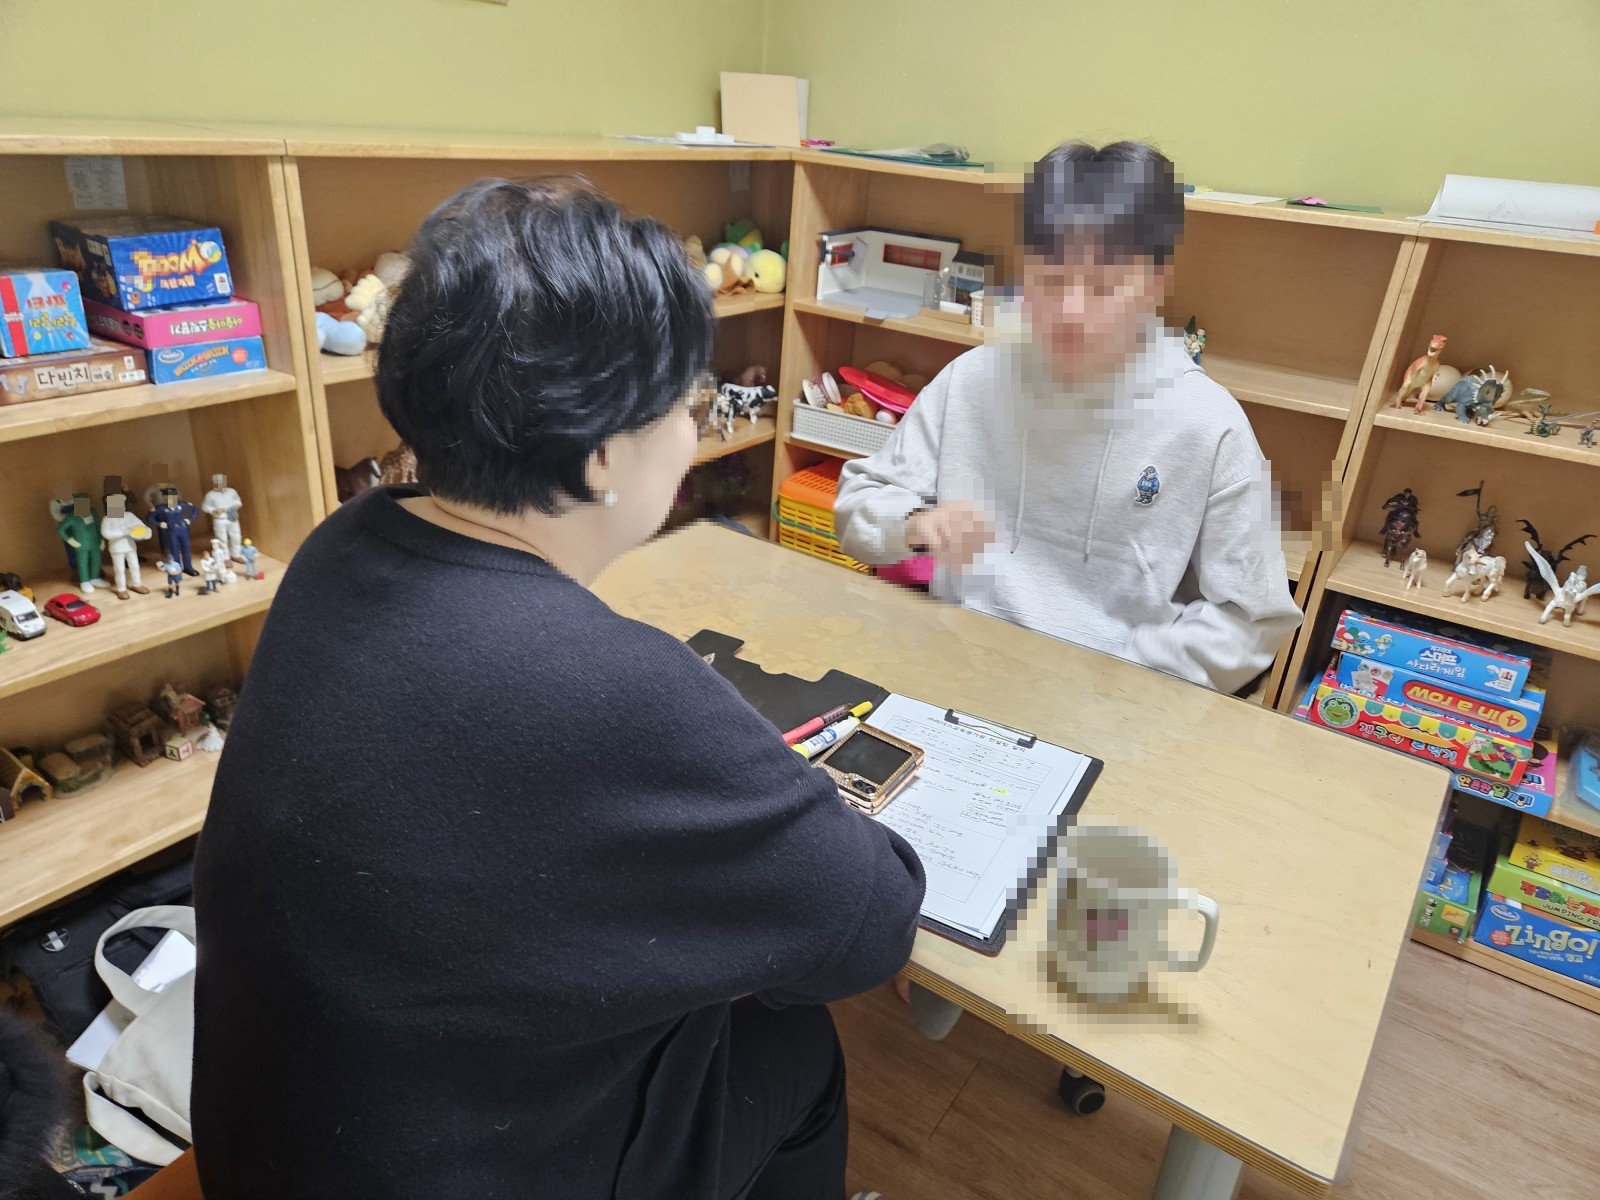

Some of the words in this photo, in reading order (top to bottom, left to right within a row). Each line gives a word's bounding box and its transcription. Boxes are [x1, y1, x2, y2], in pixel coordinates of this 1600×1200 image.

[38, 365, 89, 387] 다빈치
[1419, 648, 1459, 666] 스머프
[1406, 686, 1453, 708] row
[1456, 700, 1474, 712] a
[1478, 705, 1501, 724] in
[1505, 714, 1521, 730] 4
[1542, 903, 1585, 922] JUMPING
[1505, 925, 1599, 960] Zingo!
